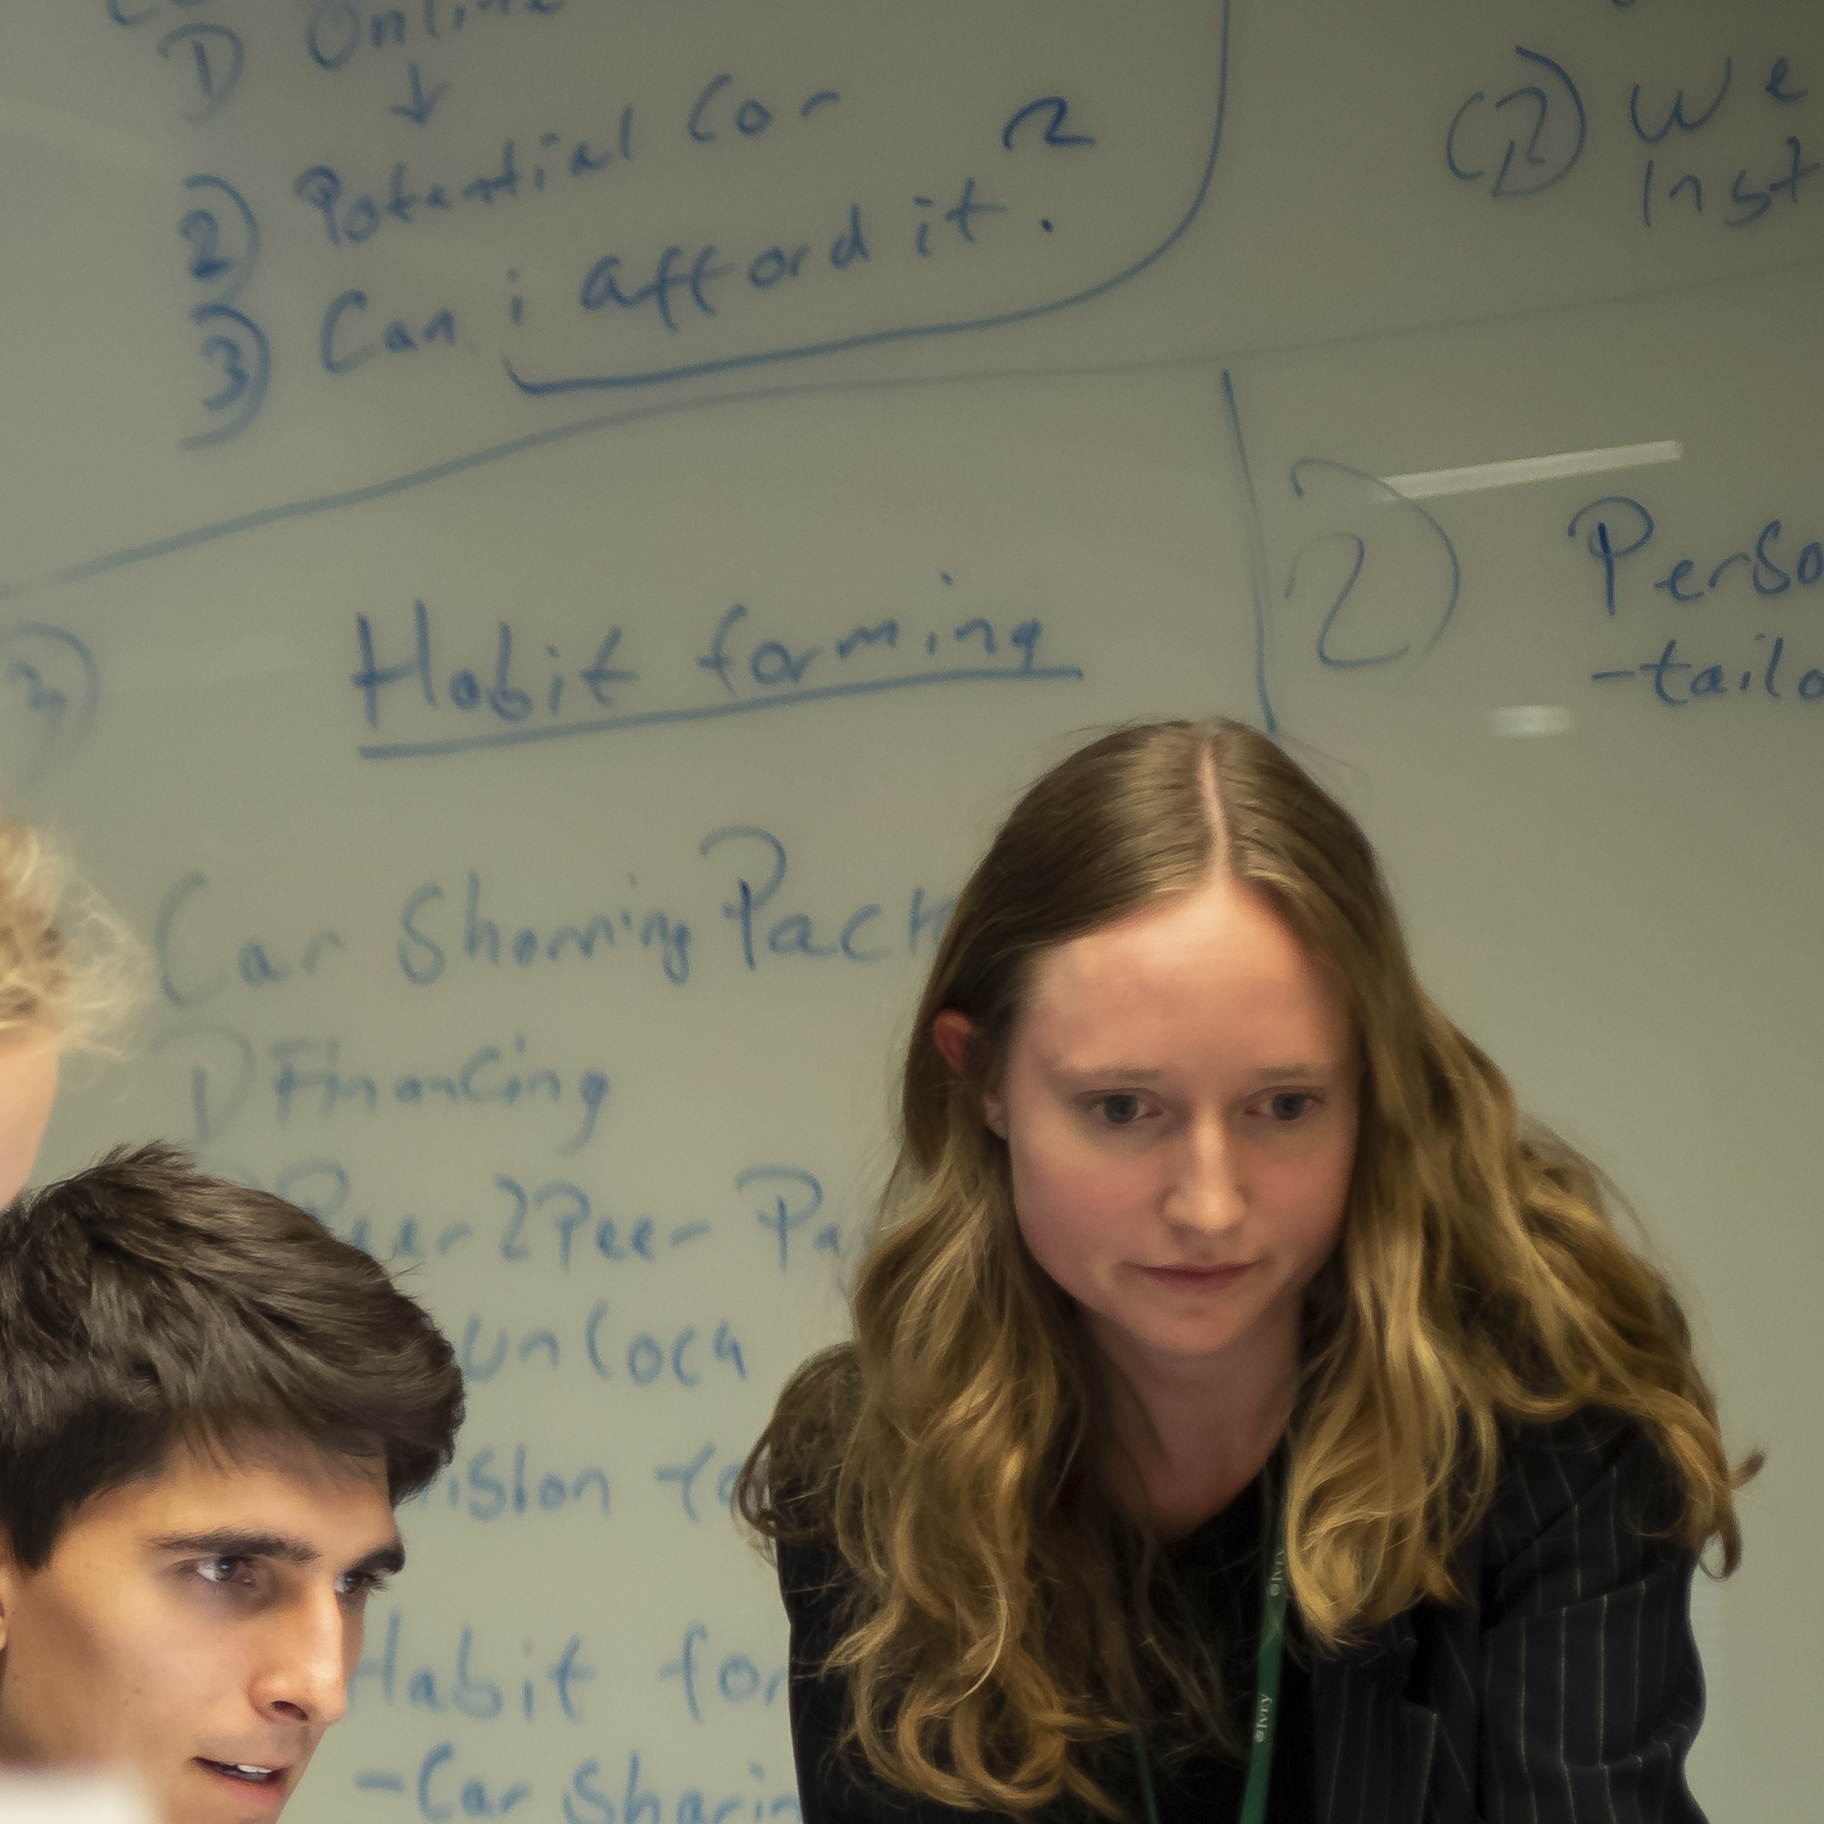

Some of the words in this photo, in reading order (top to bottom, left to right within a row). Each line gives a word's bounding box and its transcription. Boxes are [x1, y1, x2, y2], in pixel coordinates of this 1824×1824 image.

[293, 104, 634, 247] Potential
[318, 289, 458, 376] Can
[578, 200, 871, 334] afford
[351, 598, 642, 732] Habit
[695, 575, 1044, 700] forming
[153, 868, 347, 1010] Car
